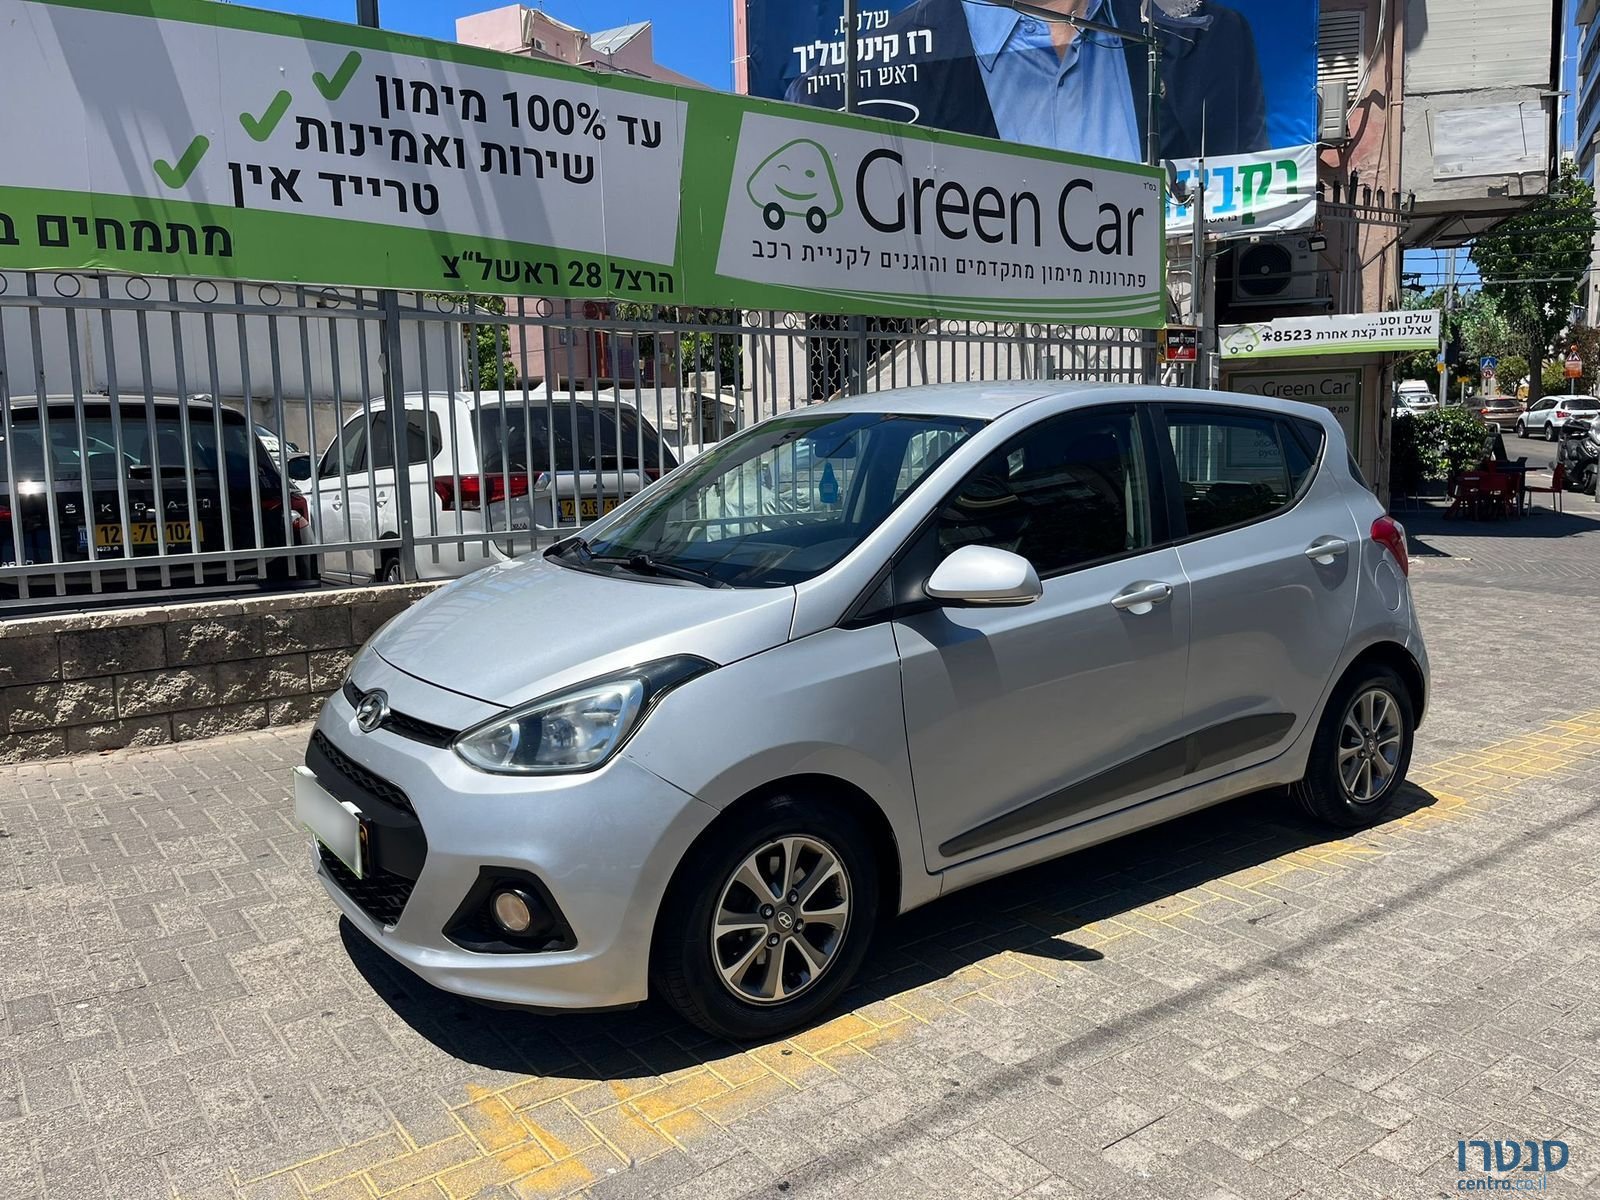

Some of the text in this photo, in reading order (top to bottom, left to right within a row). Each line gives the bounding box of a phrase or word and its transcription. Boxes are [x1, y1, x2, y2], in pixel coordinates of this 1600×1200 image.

[906, 28, 933, 55] רז
[807, 63, 918, 95] ראש הירייה
[374, 74, 661, 149] עד 100% מימון
[295, 115, 594, 185] שירות ואמינות
[228, 161, 440, 216] טרייד אין
[855, 148, 1145, 257] Green Car
[36, 214, 234, 258] מתמחים
[567, 260, 603, 289] 28
[609, 262, 675, 294] הרצל
[752, 240, 1147, 288] פתרונות מימון מתקדמים והוגנים לקניית רכב
[1380, 327, 1395, 337] זה
[1397, 325, 1432, 336] אצלנו
[1404, 314, 1432, 325] שלם
[1316, 330, 1348, 340] אחרת
[1352, 328, 1377, 342] קצת
[1262, 379, 1351, 397] Green Car
